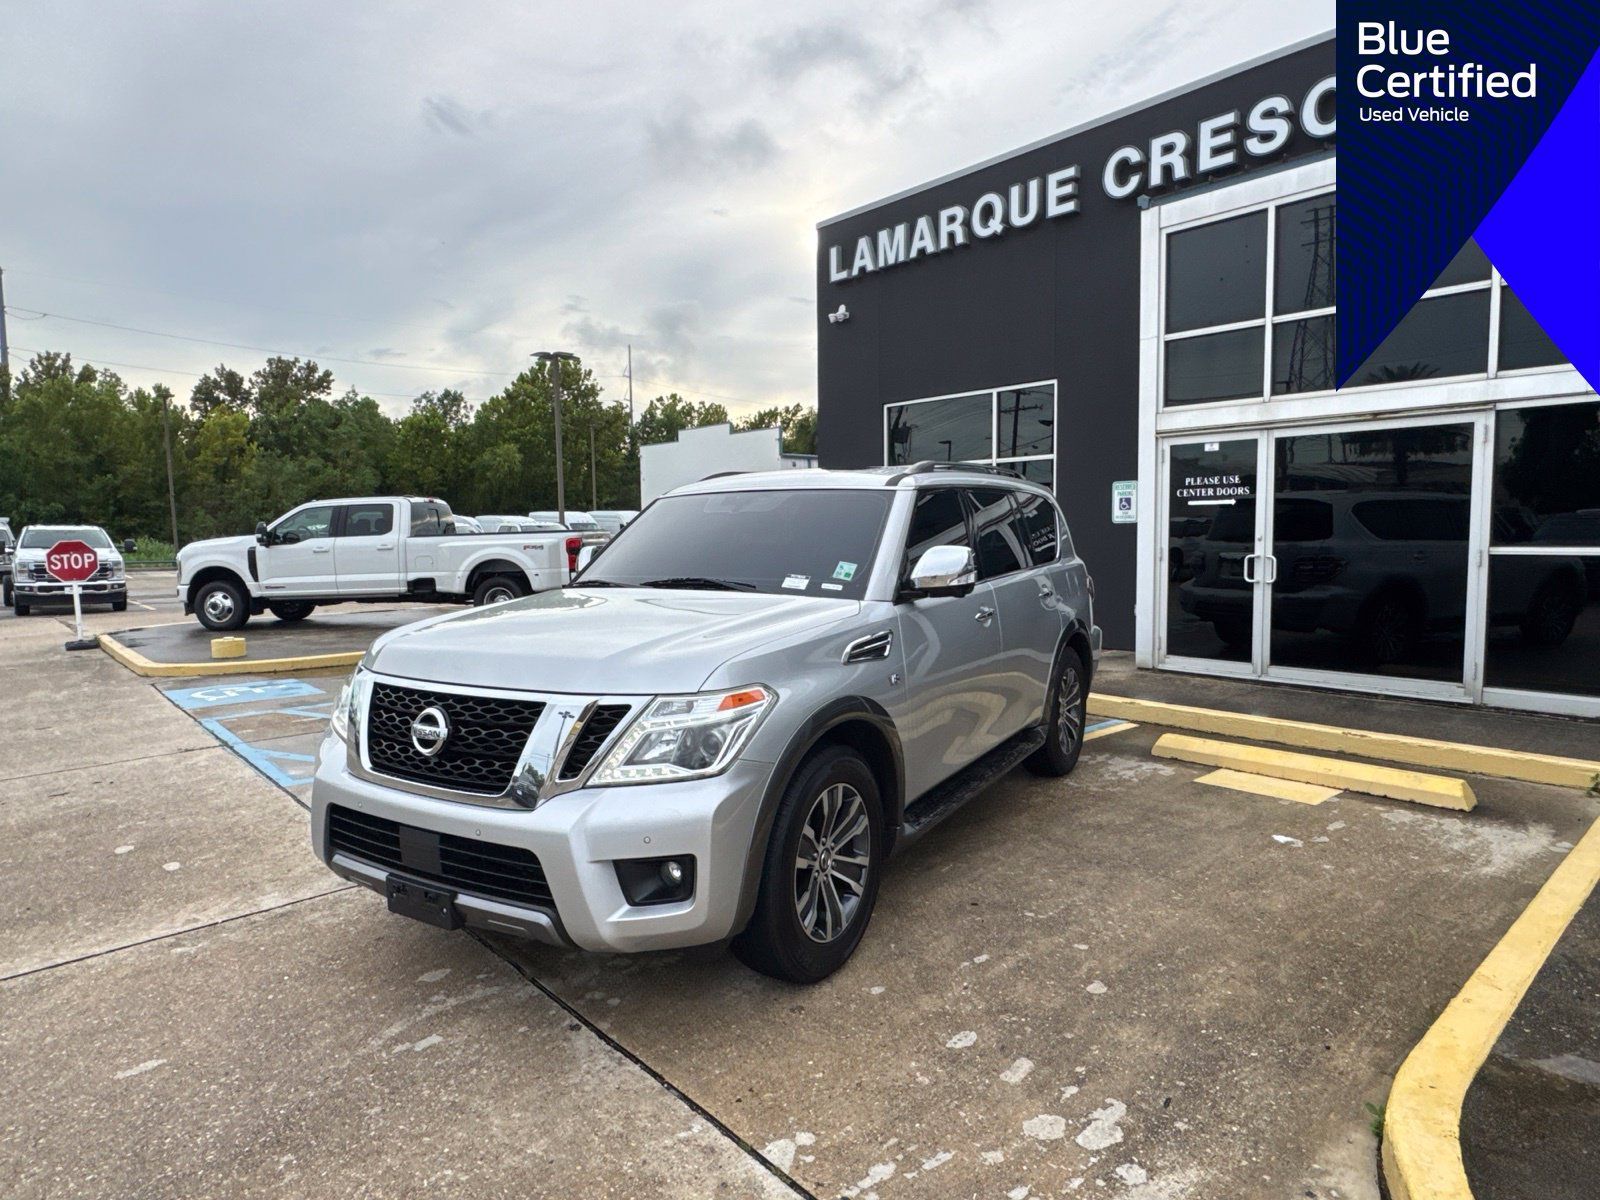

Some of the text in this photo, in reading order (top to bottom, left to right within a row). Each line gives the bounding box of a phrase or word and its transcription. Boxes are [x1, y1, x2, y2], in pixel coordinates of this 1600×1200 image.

[829, 164, 1080, 283] LAMARQUE
[1185, 474, 1241, 486] PLEASE USE
[1176, 486, 1250, 497] CENTER DOORS
[50, 553, 95, 570] STOP
